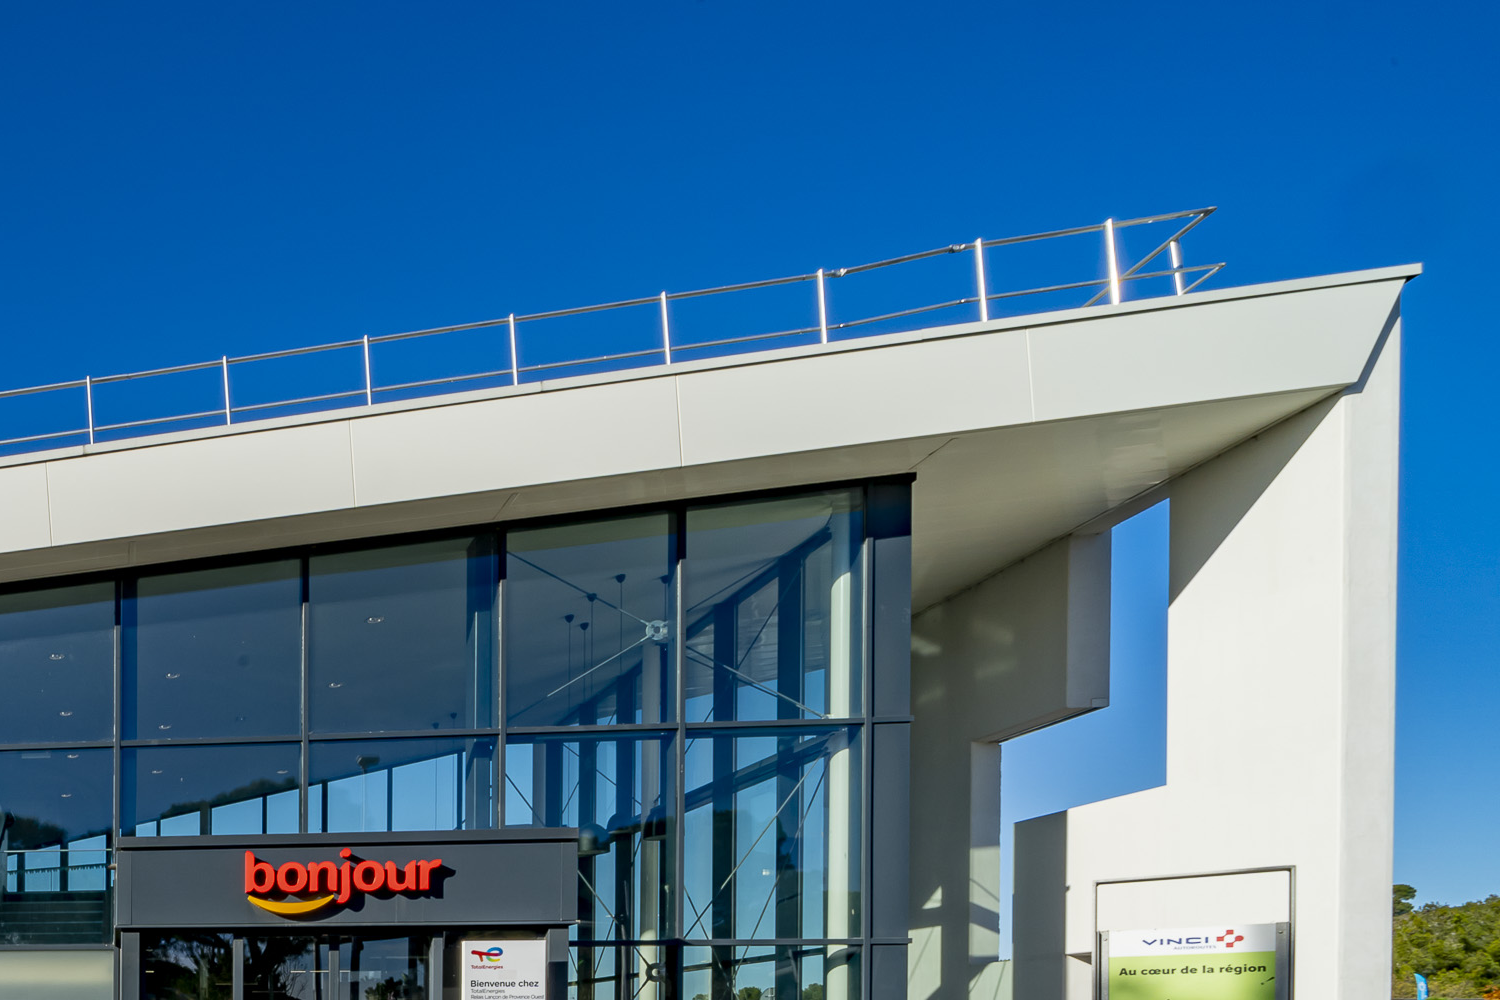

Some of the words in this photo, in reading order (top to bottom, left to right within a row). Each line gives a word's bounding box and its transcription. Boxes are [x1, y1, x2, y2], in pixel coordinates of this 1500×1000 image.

[245, 847, 442, 904] bonjour
[1142, 936, 1209, 946] VINCI
[1118, 967, 1137, 976] Au
[1140, 967, 1177, 976] cœur
[1180, 965, 1198, 975] de
[1202, 965, 1215, 974] la
[1219, 963, 1267, 975] région
[470, 980, 516, 988] Bienvenue
[518, 980, 539, 988] chez
